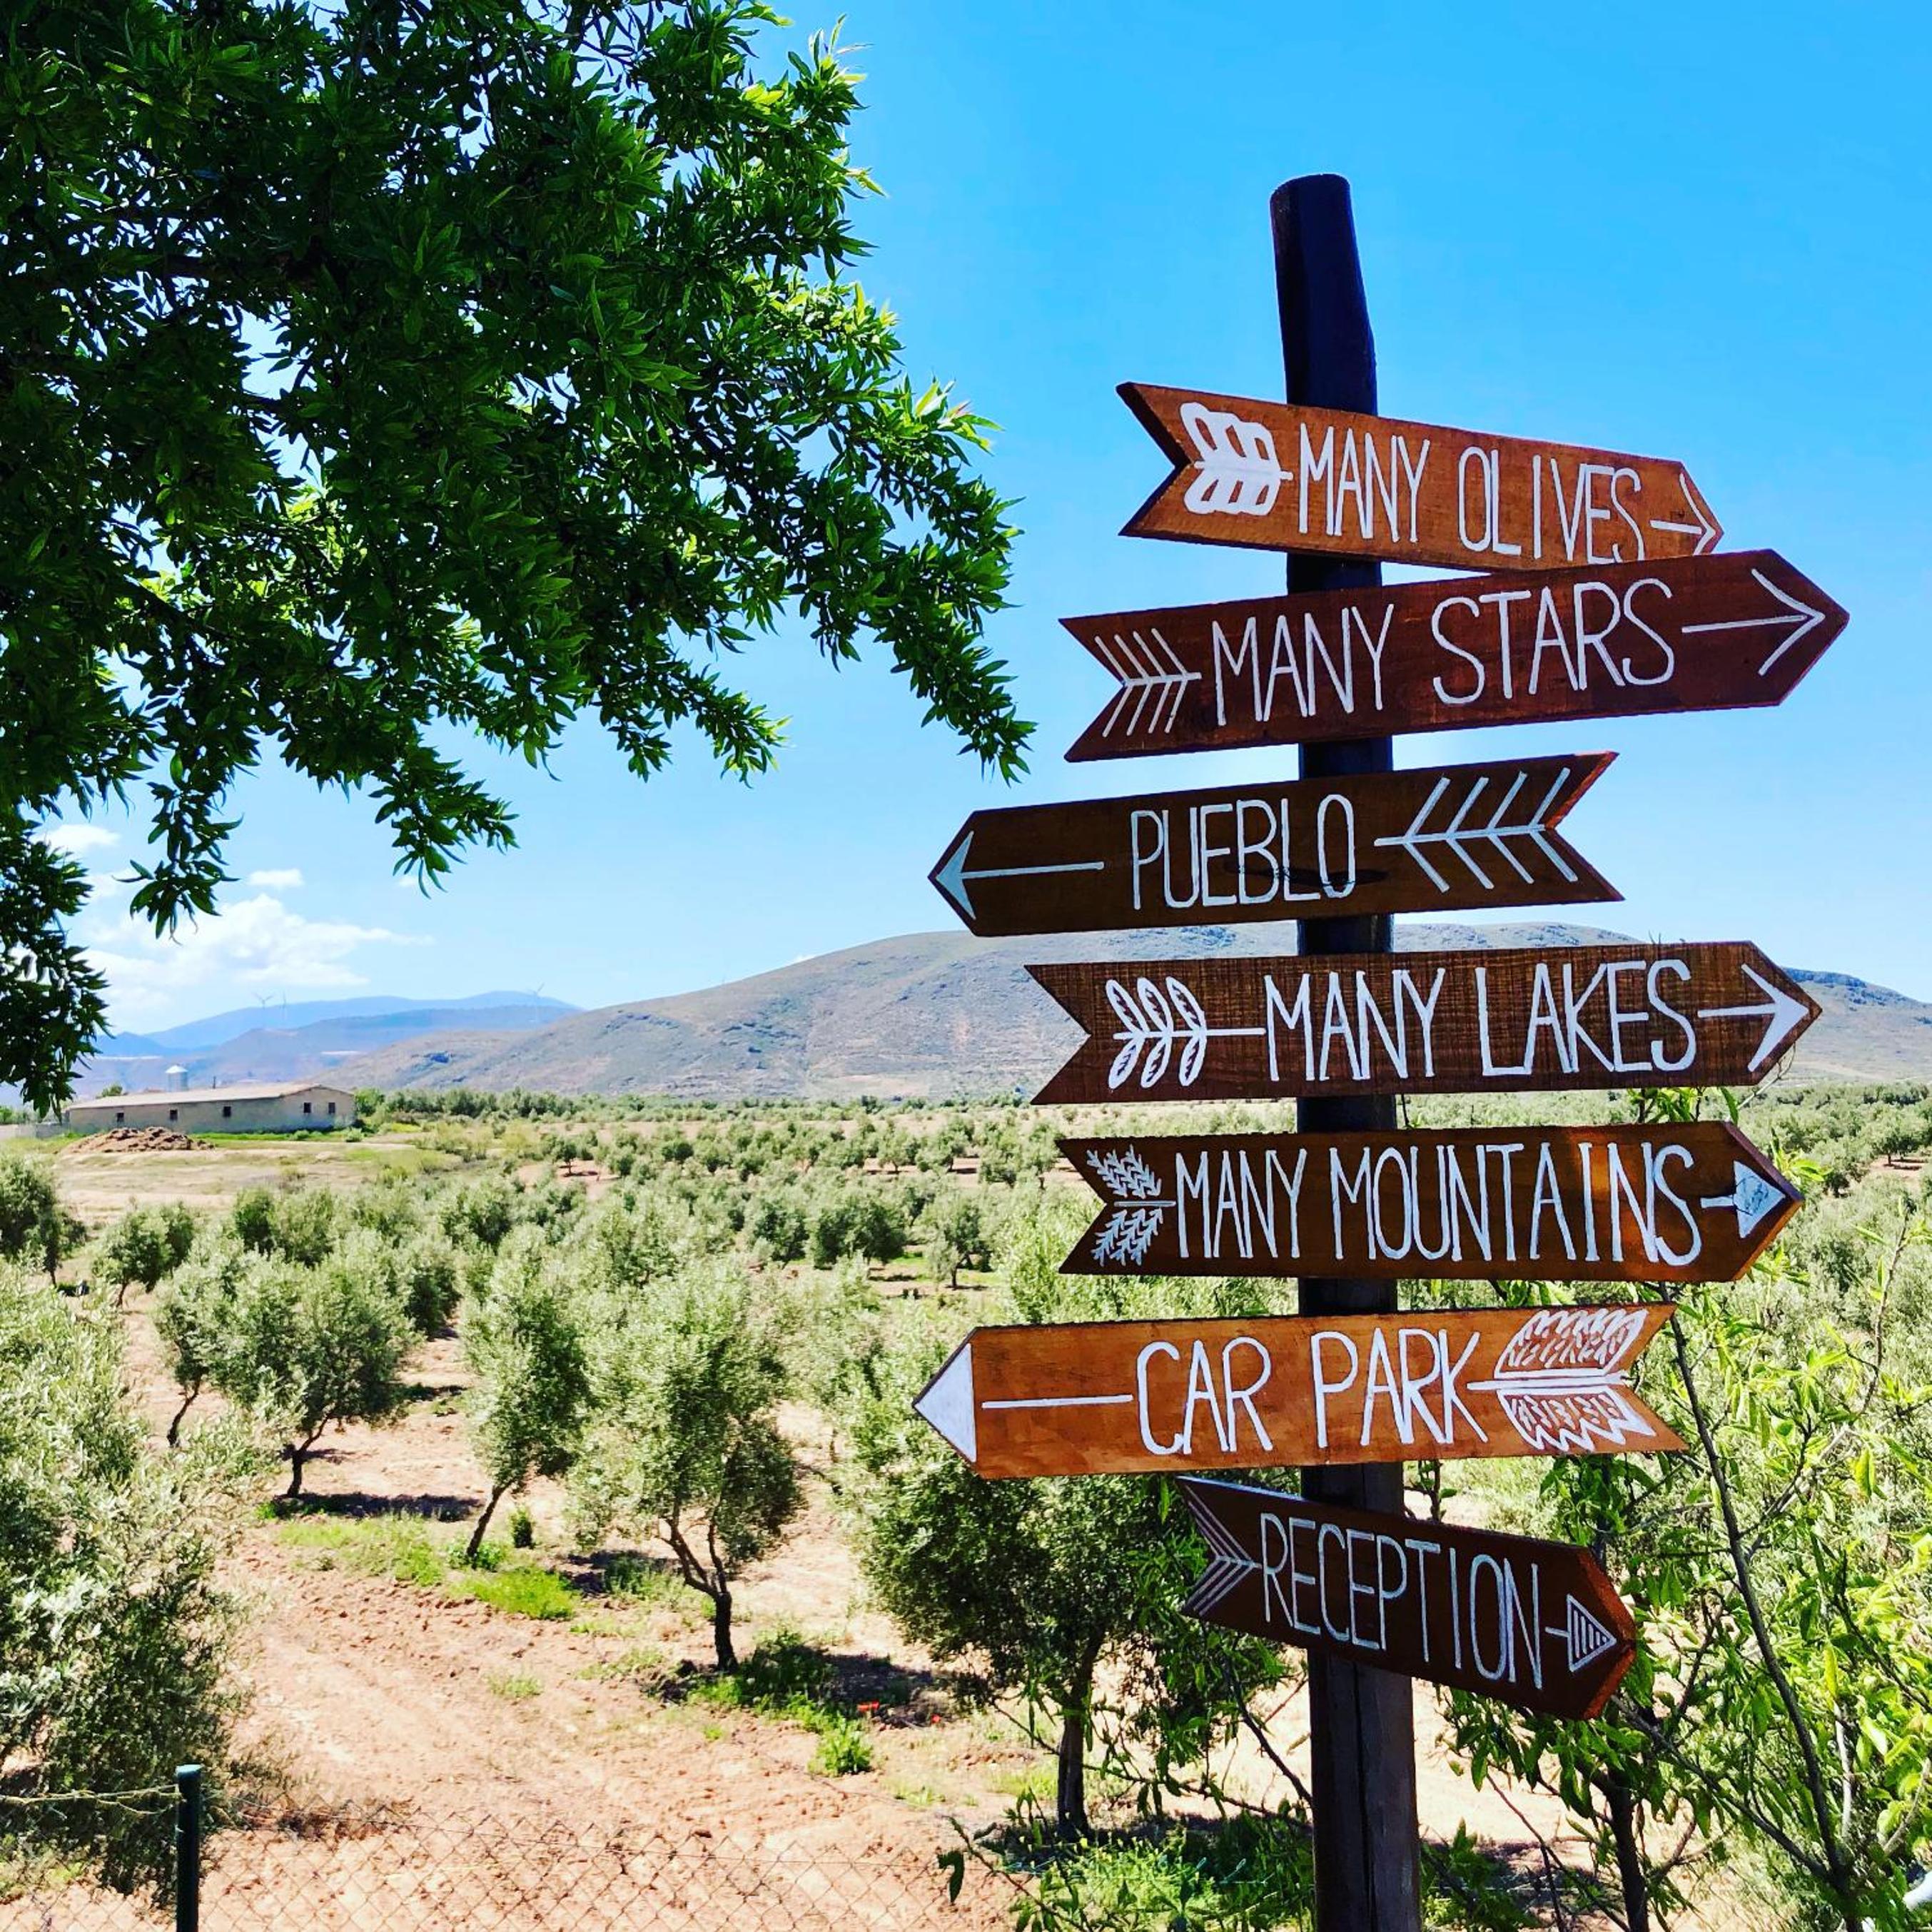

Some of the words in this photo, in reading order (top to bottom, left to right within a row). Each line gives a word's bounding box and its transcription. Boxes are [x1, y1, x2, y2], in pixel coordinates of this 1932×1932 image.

[1299, 422, 1431, 543] MANY
[1457, 445, 1644, 565] OLIVES
[1211, 603, 1395, 727] MANY
[1433, 580, 1674, 704] STARS
[1130, 794, 1357, 910] PUEBLO
[1264, 966, 1446, 1082] MANY
[1477, 961, 1697, 1076] LAKES
[1174, 1147, 1308, 1260] MANY
[1329, 1142, 1703, 1266] MOUNTAINS
[1136, 1336, 1275, 1455] CAR
[1310, 1327, 1488, 1449] PARK
[1260, 1512, 1544, 1690] RECEPTION
